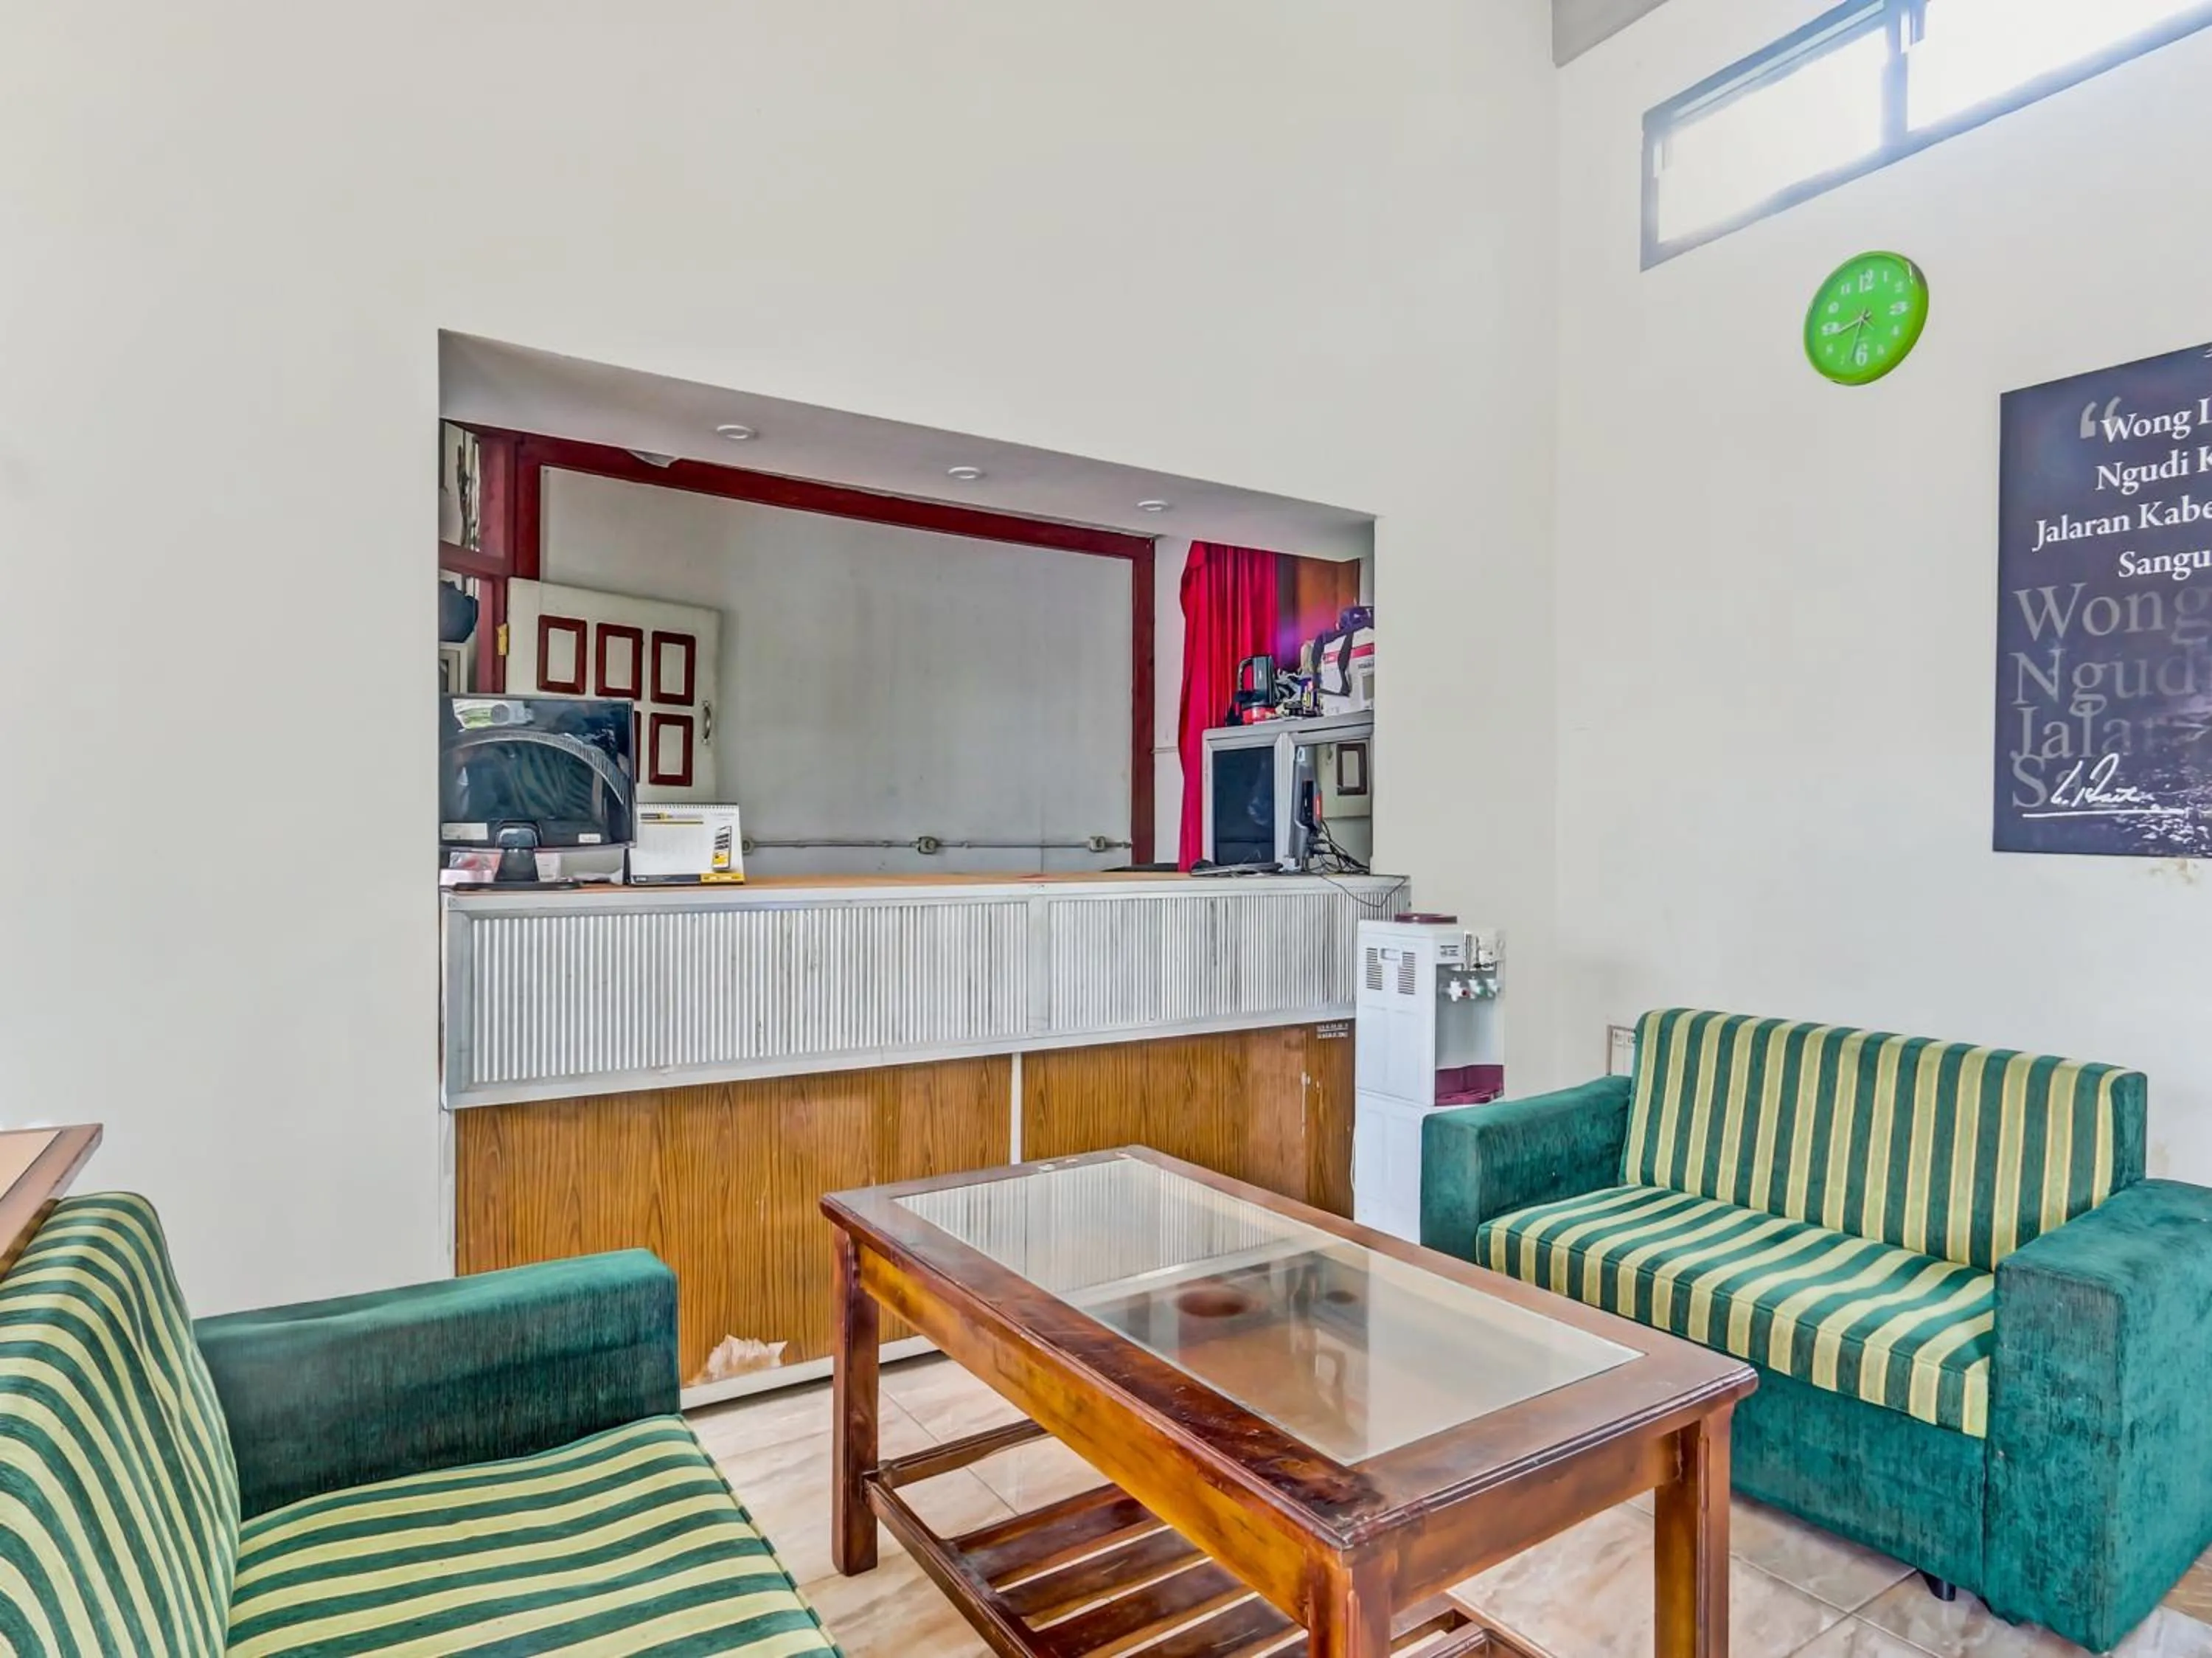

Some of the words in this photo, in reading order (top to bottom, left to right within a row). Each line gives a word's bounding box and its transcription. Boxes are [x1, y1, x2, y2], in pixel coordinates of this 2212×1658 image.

[1859, 268, 1874, 293] 12
[2100, 412, 2192, 442] Wong
[2095, 449, 2189, 495] Ngudi
[2031, 514, 2130, 552] Jalaran
[2118, 549, 2212, 580] Sangu
[2013, 582, 2212, 645] Wong
